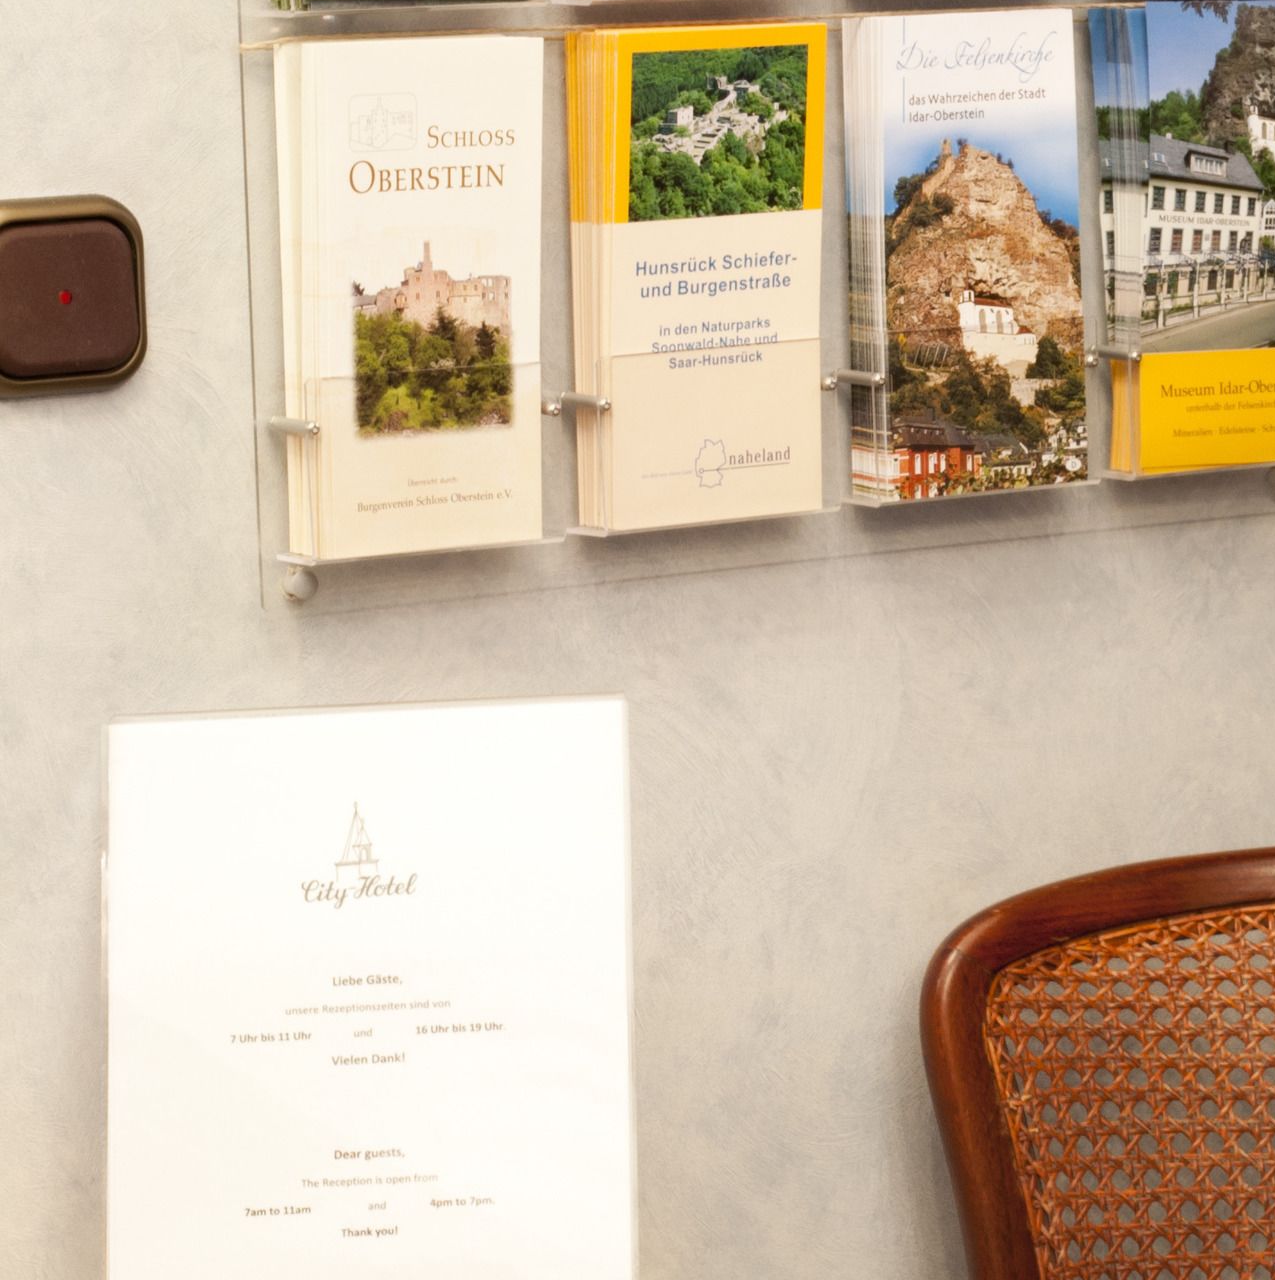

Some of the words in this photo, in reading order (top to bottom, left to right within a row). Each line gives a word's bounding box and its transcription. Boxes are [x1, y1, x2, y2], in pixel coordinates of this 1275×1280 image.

[896, 39, 940, 71] Die
[944, 31, 1057, 84] Felsenkirche
[909, 94, 926, 106] das
[929, 91, 996, 105] Wahrzeichen
[999, 90, 1015, 101] der
[1018, 88, 1046, 100] Stadt
[909, 108, 985, 123] Idar-Oberstein
[427, 125, 516, 149] SCHLOSS
[349, 160, 505, 194] OBERSTEIN
[636, 256, 716, 276] Hunsrück
[722, 251, 797, 270] Schiefer-
[640, 282, 672, 298] und
[677, 273, 791, 297] Burgenstraße
[659, 325, 670, 337] in
[674, 323, 697, 336] den
[701, 317, 771, 333] Naturparks
[652, 335, 750, 354] Soonwald-Nahe
[754, 332, 778, 345] und
[668, 350, 763, 369] Saar-Hunsrück
[1161, 384, 1215, 398] Museum
[729, 446, 791, 466] naheland
[357, 498, 413, 514] Burgenverein
[416, 494, 448, 506] Schloss
[450, 491, 494, 504] Oberstein
[332, 976, 363, 987] Liebe
[366, 974, 403, 985] Gäste,
[285, 1006, 319, 1015] unsere
[322, 1002, 407, 1014] Rezeptionszeiten
[409, 1000, 430, 1009] sind
[239, 1034, 258, 1043] Uhr
[261, 1032, 275, 1042] bis
[279, 1032, 290, 1041] 11
[293, 1031, 312, 1040] Uhr
[353, 1028, 373, 1038] und
[416, 1025, 428, 1035] 16
[431, 1025, 450, 1034] Uhr
[452, 1023, 466, 1033] bis
[470, 1023, 481, 1032] 19
[331, 1055, 368, 1066] Vielen
[371, 1052, 405, 1064] Dank!
[334, 1149, 361, 1160] Dear
[364, 1148, 405, 1161] guests,
[301, 1178, 320, 1188] The
[322, 1176, 372, 1187] Reception
[375, 1176, 383, 1185] is
[386, 1175, 411, 1187] open
[414, 1173, 438, 1183] from
[244, 1207, 266, 1217] 7am
[269, 1207, 280, 1216] to
[283, 1206, 311, 1215] 11am
[368, 1201, 387, 1211] and
[430, 1198, 453, 1209] 4pm
[455, 1197, 467, 1207] to
[341, 1228, 372, 1238] Thank
[375, 1226, 398, 1238] you!
